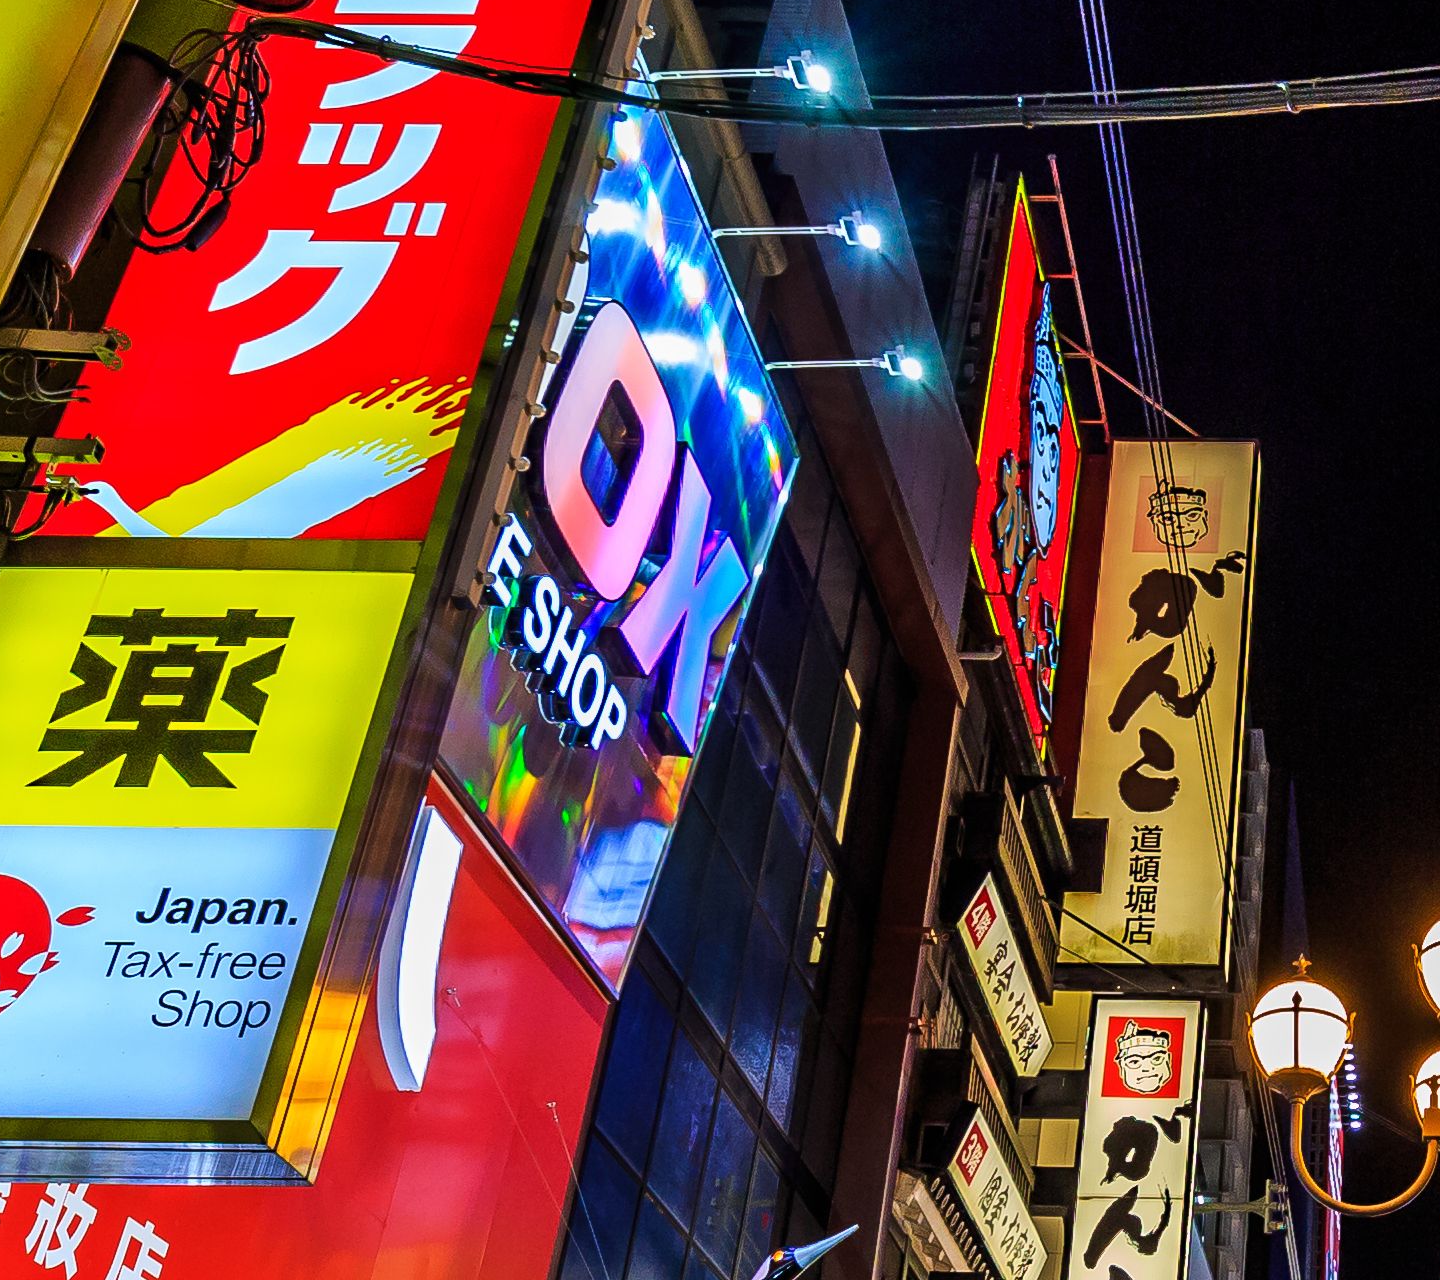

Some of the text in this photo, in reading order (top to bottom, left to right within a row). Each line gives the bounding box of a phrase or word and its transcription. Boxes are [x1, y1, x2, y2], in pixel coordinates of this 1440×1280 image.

[25, 608, 295, 790] 薬
[522, 576, 627, 753] SHOP
[1108, 550, 1245, 815] がんこ
[135, 888, 299, 931] Japan.
[1122, 825, 1162, 946] 道頓堀店
[102, 941, 287, 982] Tax-free
[151, 989, 273, 1038] Shop
